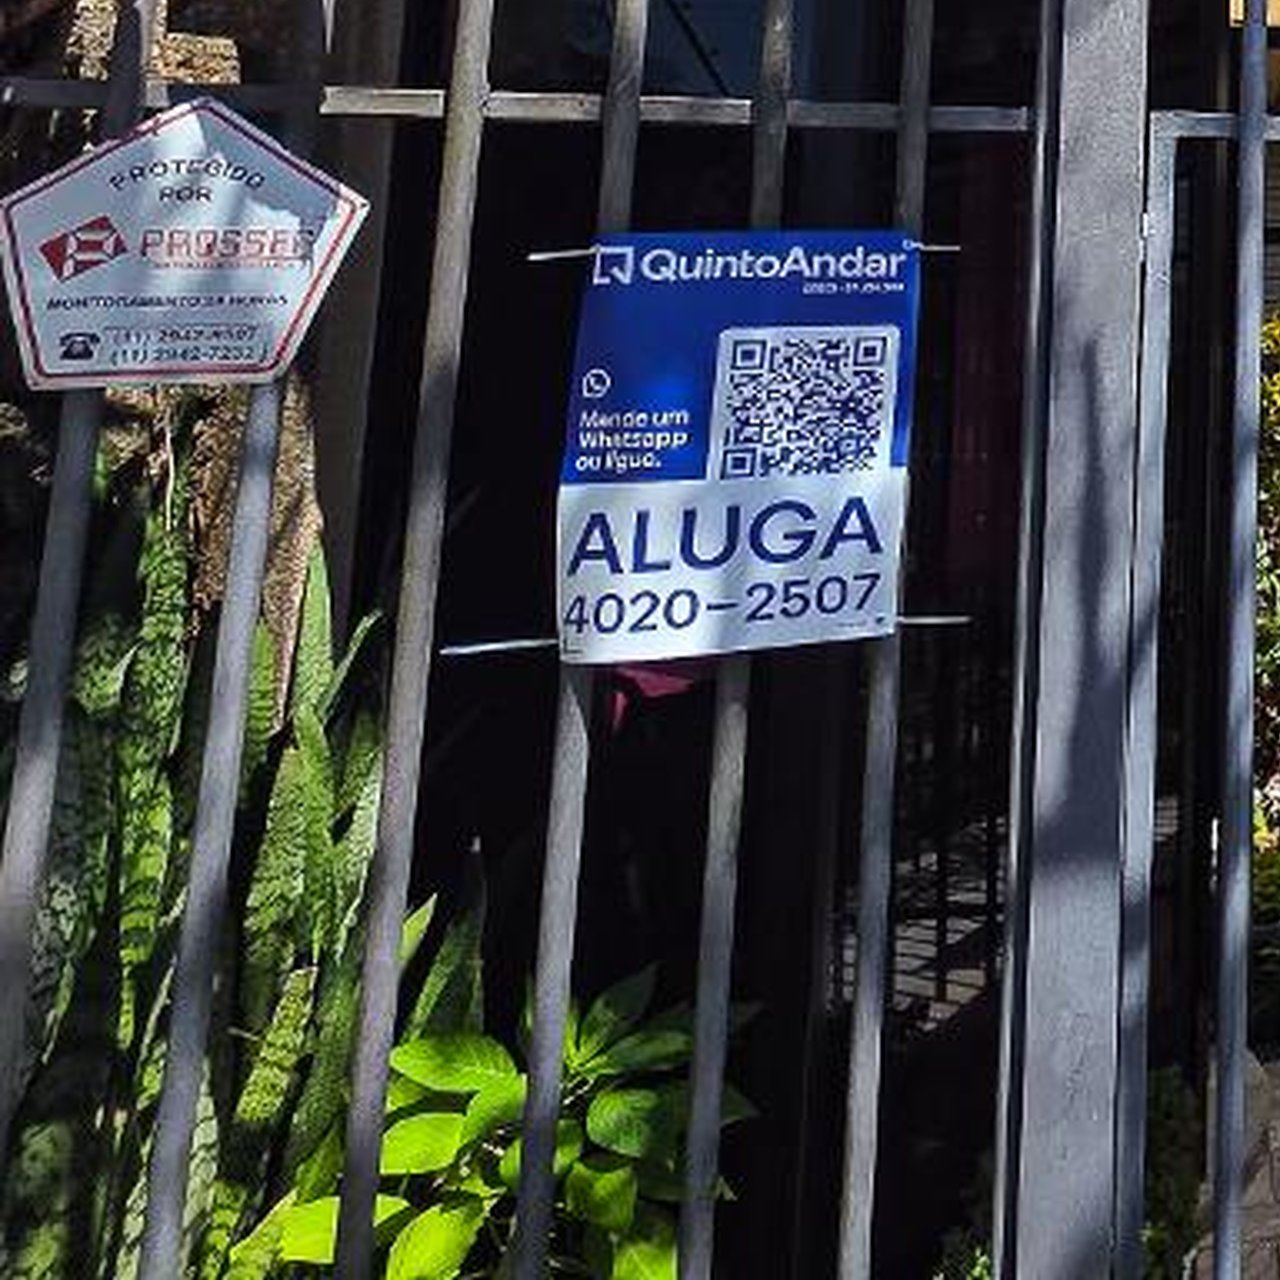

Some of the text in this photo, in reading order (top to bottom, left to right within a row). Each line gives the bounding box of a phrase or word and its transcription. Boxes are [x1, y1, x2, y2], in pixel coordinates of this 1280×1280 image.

[108, 158, 266, 192] PROTEGIDO
[158, 185, 213, 203] POR
[640, 245, 907, 283] QuintoAndar
[580, 410, 689, 428] Mande um
[575, 455, 602, 472] ou
[566, 496, 884, 576] ALUGA
[563, 572, 882, 634] 4020-2507
